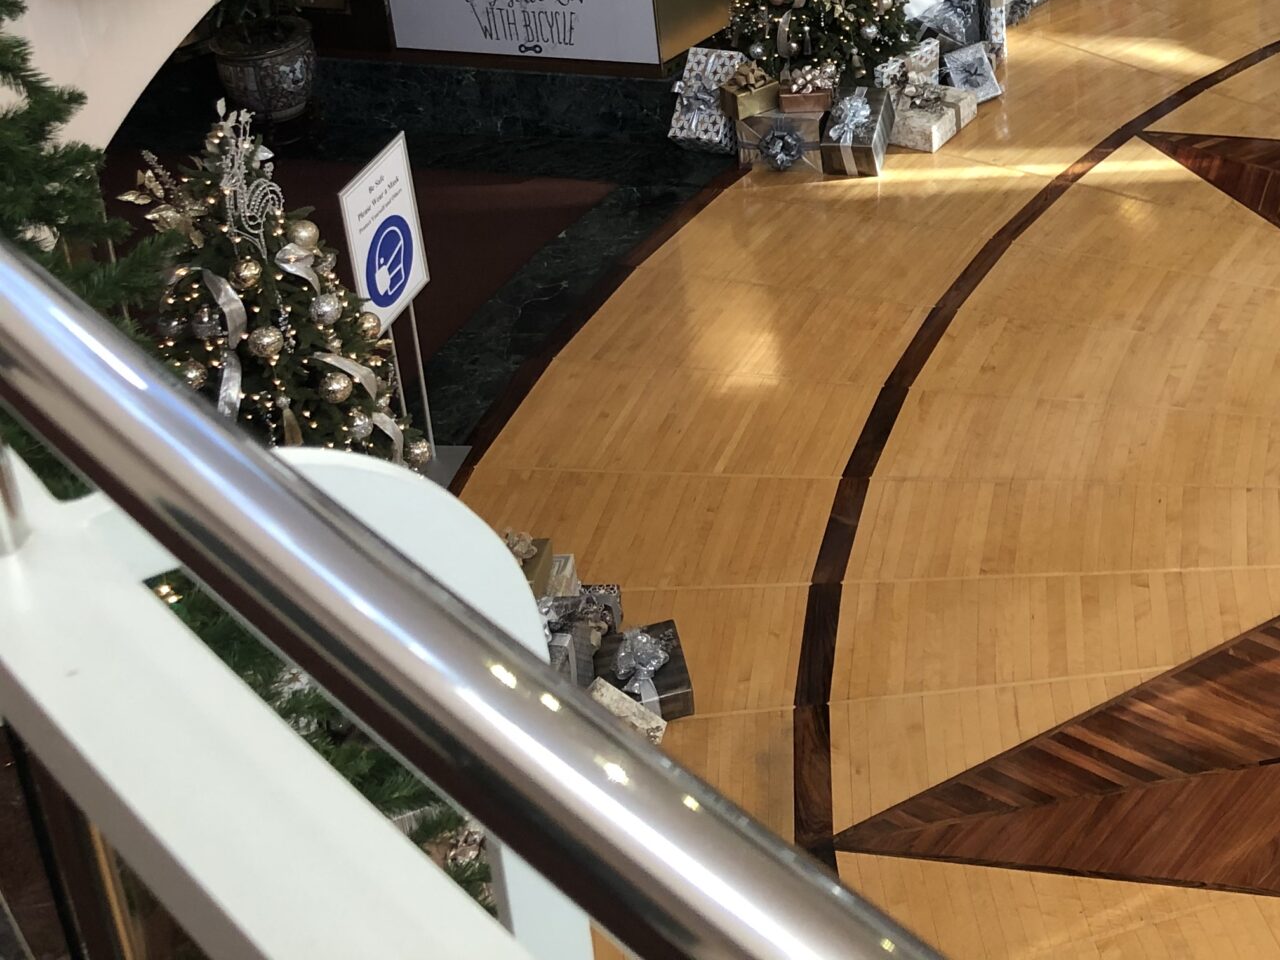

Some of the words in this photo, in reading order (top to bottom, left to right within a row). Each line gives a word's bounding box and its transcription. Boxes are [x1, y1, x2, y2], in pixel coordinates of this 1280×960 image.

[470, 3, 519, 41] WITH
[522, 10, 576, 46] BICYCLE
[357, 205, 372, 221] Please
[372, 192, 384, 205] Wear
[387, 176, 399, 189] Mask
